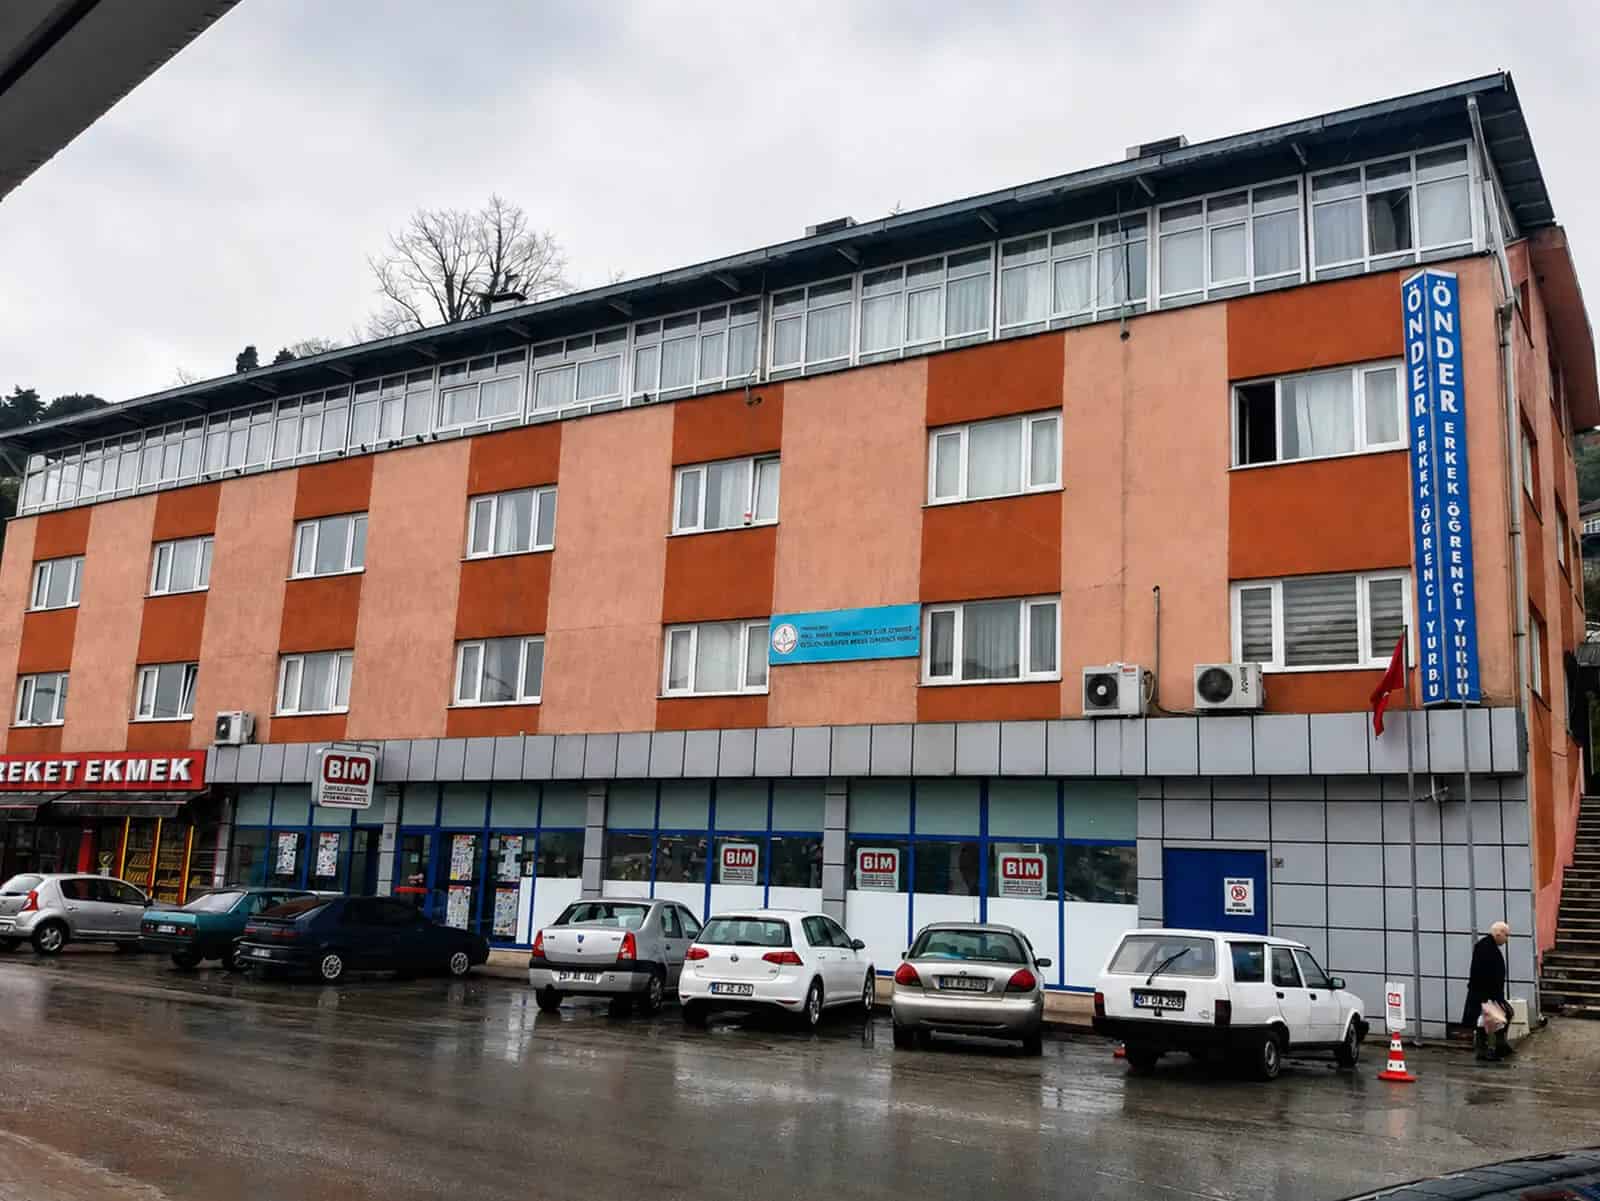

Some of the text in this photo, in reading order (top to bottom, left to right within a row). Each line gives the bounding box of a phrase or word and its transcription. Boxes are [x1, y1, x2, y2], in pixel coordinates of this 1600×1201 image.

[1407, 284, 1427, 417] ÖNDER
[1417, 424, 1430, 499] ERKEK
[1432, 280, 1459, 414] ÖNDER
[1444, 421, 1460, 496] ERKEK
[84, 757, 194, 782] EKMEK
